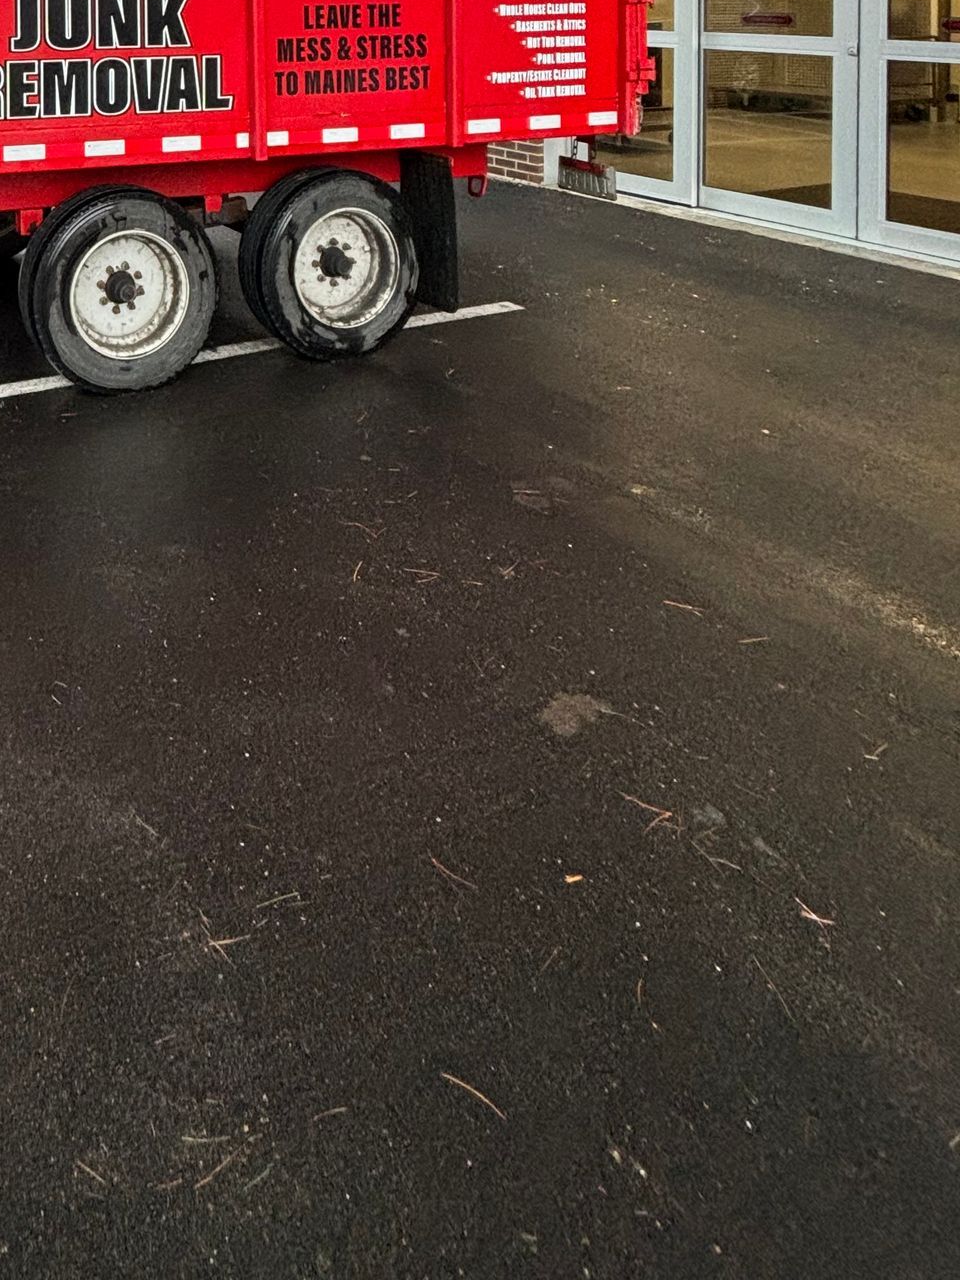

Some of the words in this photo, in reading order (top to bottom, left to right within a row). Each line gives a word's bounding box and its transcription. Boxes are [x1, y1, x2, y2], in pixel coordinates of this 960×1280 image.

[303, 4, 362, 30] LEAVE
[366, 3, 401, 28] THE
[276, 36, 332, 63] MESS
[337, 36, 352, 61] &
[356, 33, 428, 61] STRESS
[555, 35, 586, 47] REMOVAL
[555, 52, 586, 64] REMOVAL
[273, 71, 299, 96] TO
[304, 68, 380, 95] MAINES
[385, 65, 431, 91] BEST
[555, 85, 586, 97] REMOVAL
